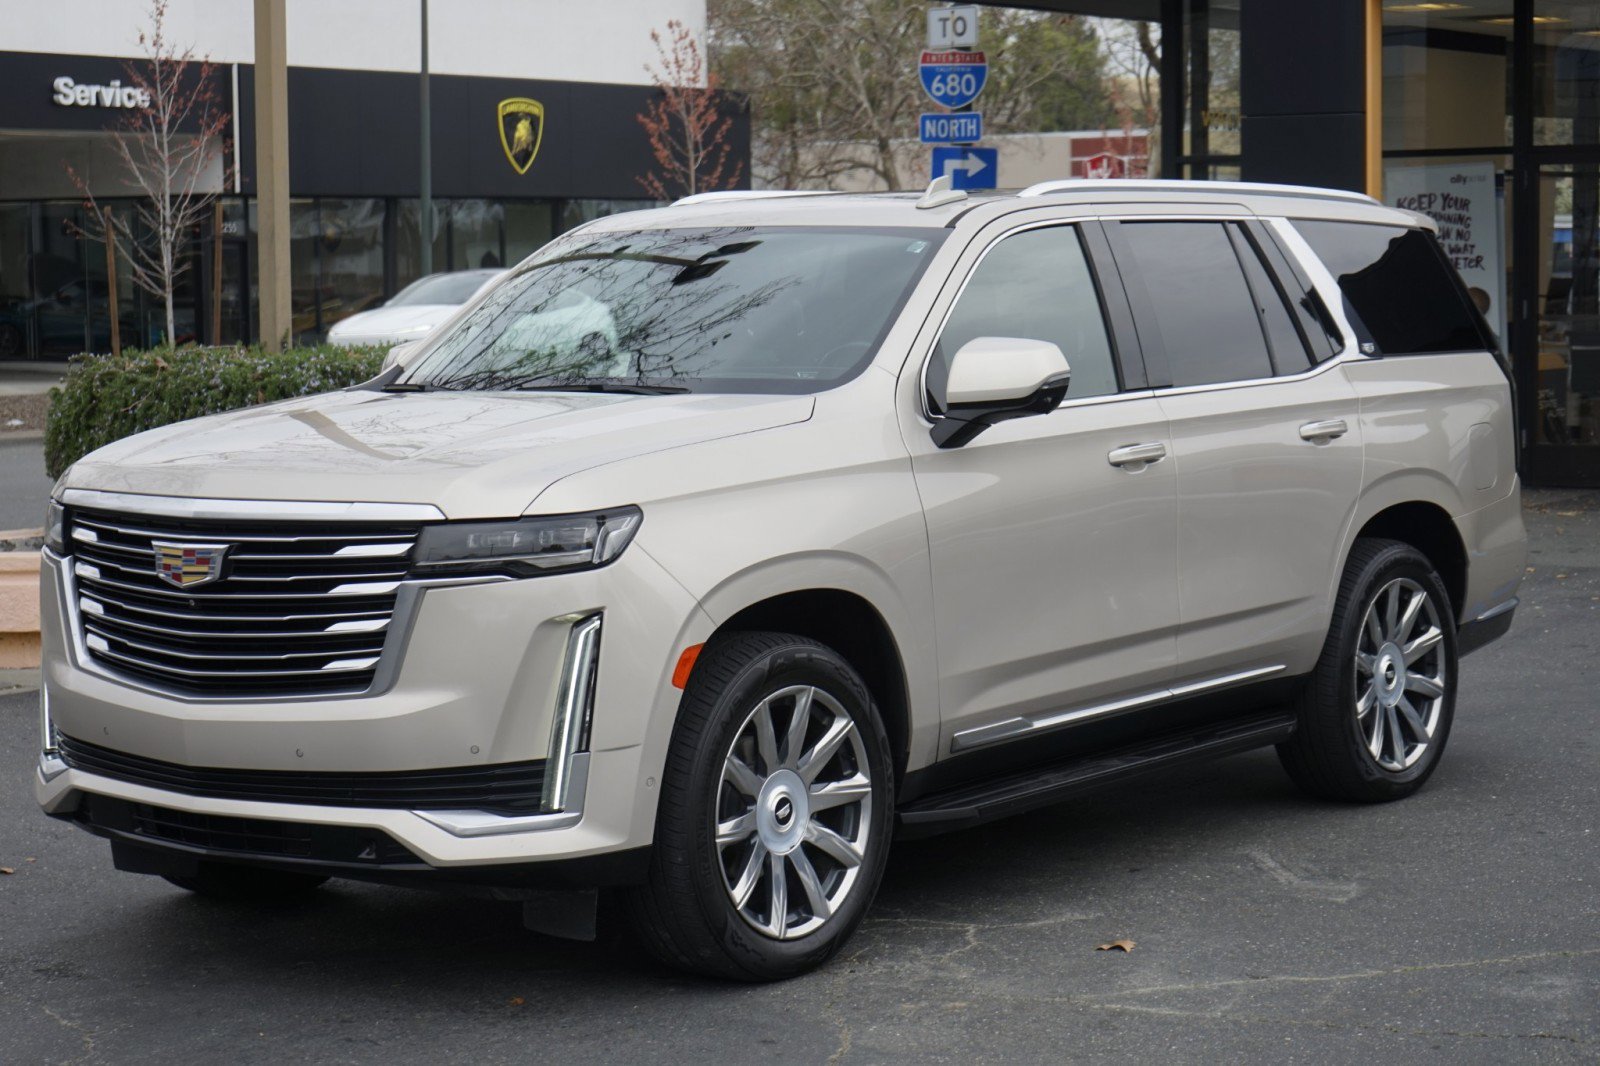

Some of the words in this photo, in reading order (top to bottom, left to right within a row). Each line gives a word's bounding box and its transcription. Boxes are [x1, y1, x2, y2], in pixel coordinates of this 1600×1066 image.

[938, 16, 967, 38] TO
[926, 54, 981, 63] INTESTATE
[53, 76, 150, 108] Service
[931, 73, 976, 96] 680
[925, 118, 977, 139] NORTH
[1441, 192, 1470, 212] YOUR
[1456, 228, 1471, 242] NO
[1448, 243, 1475, 254] WHAT
